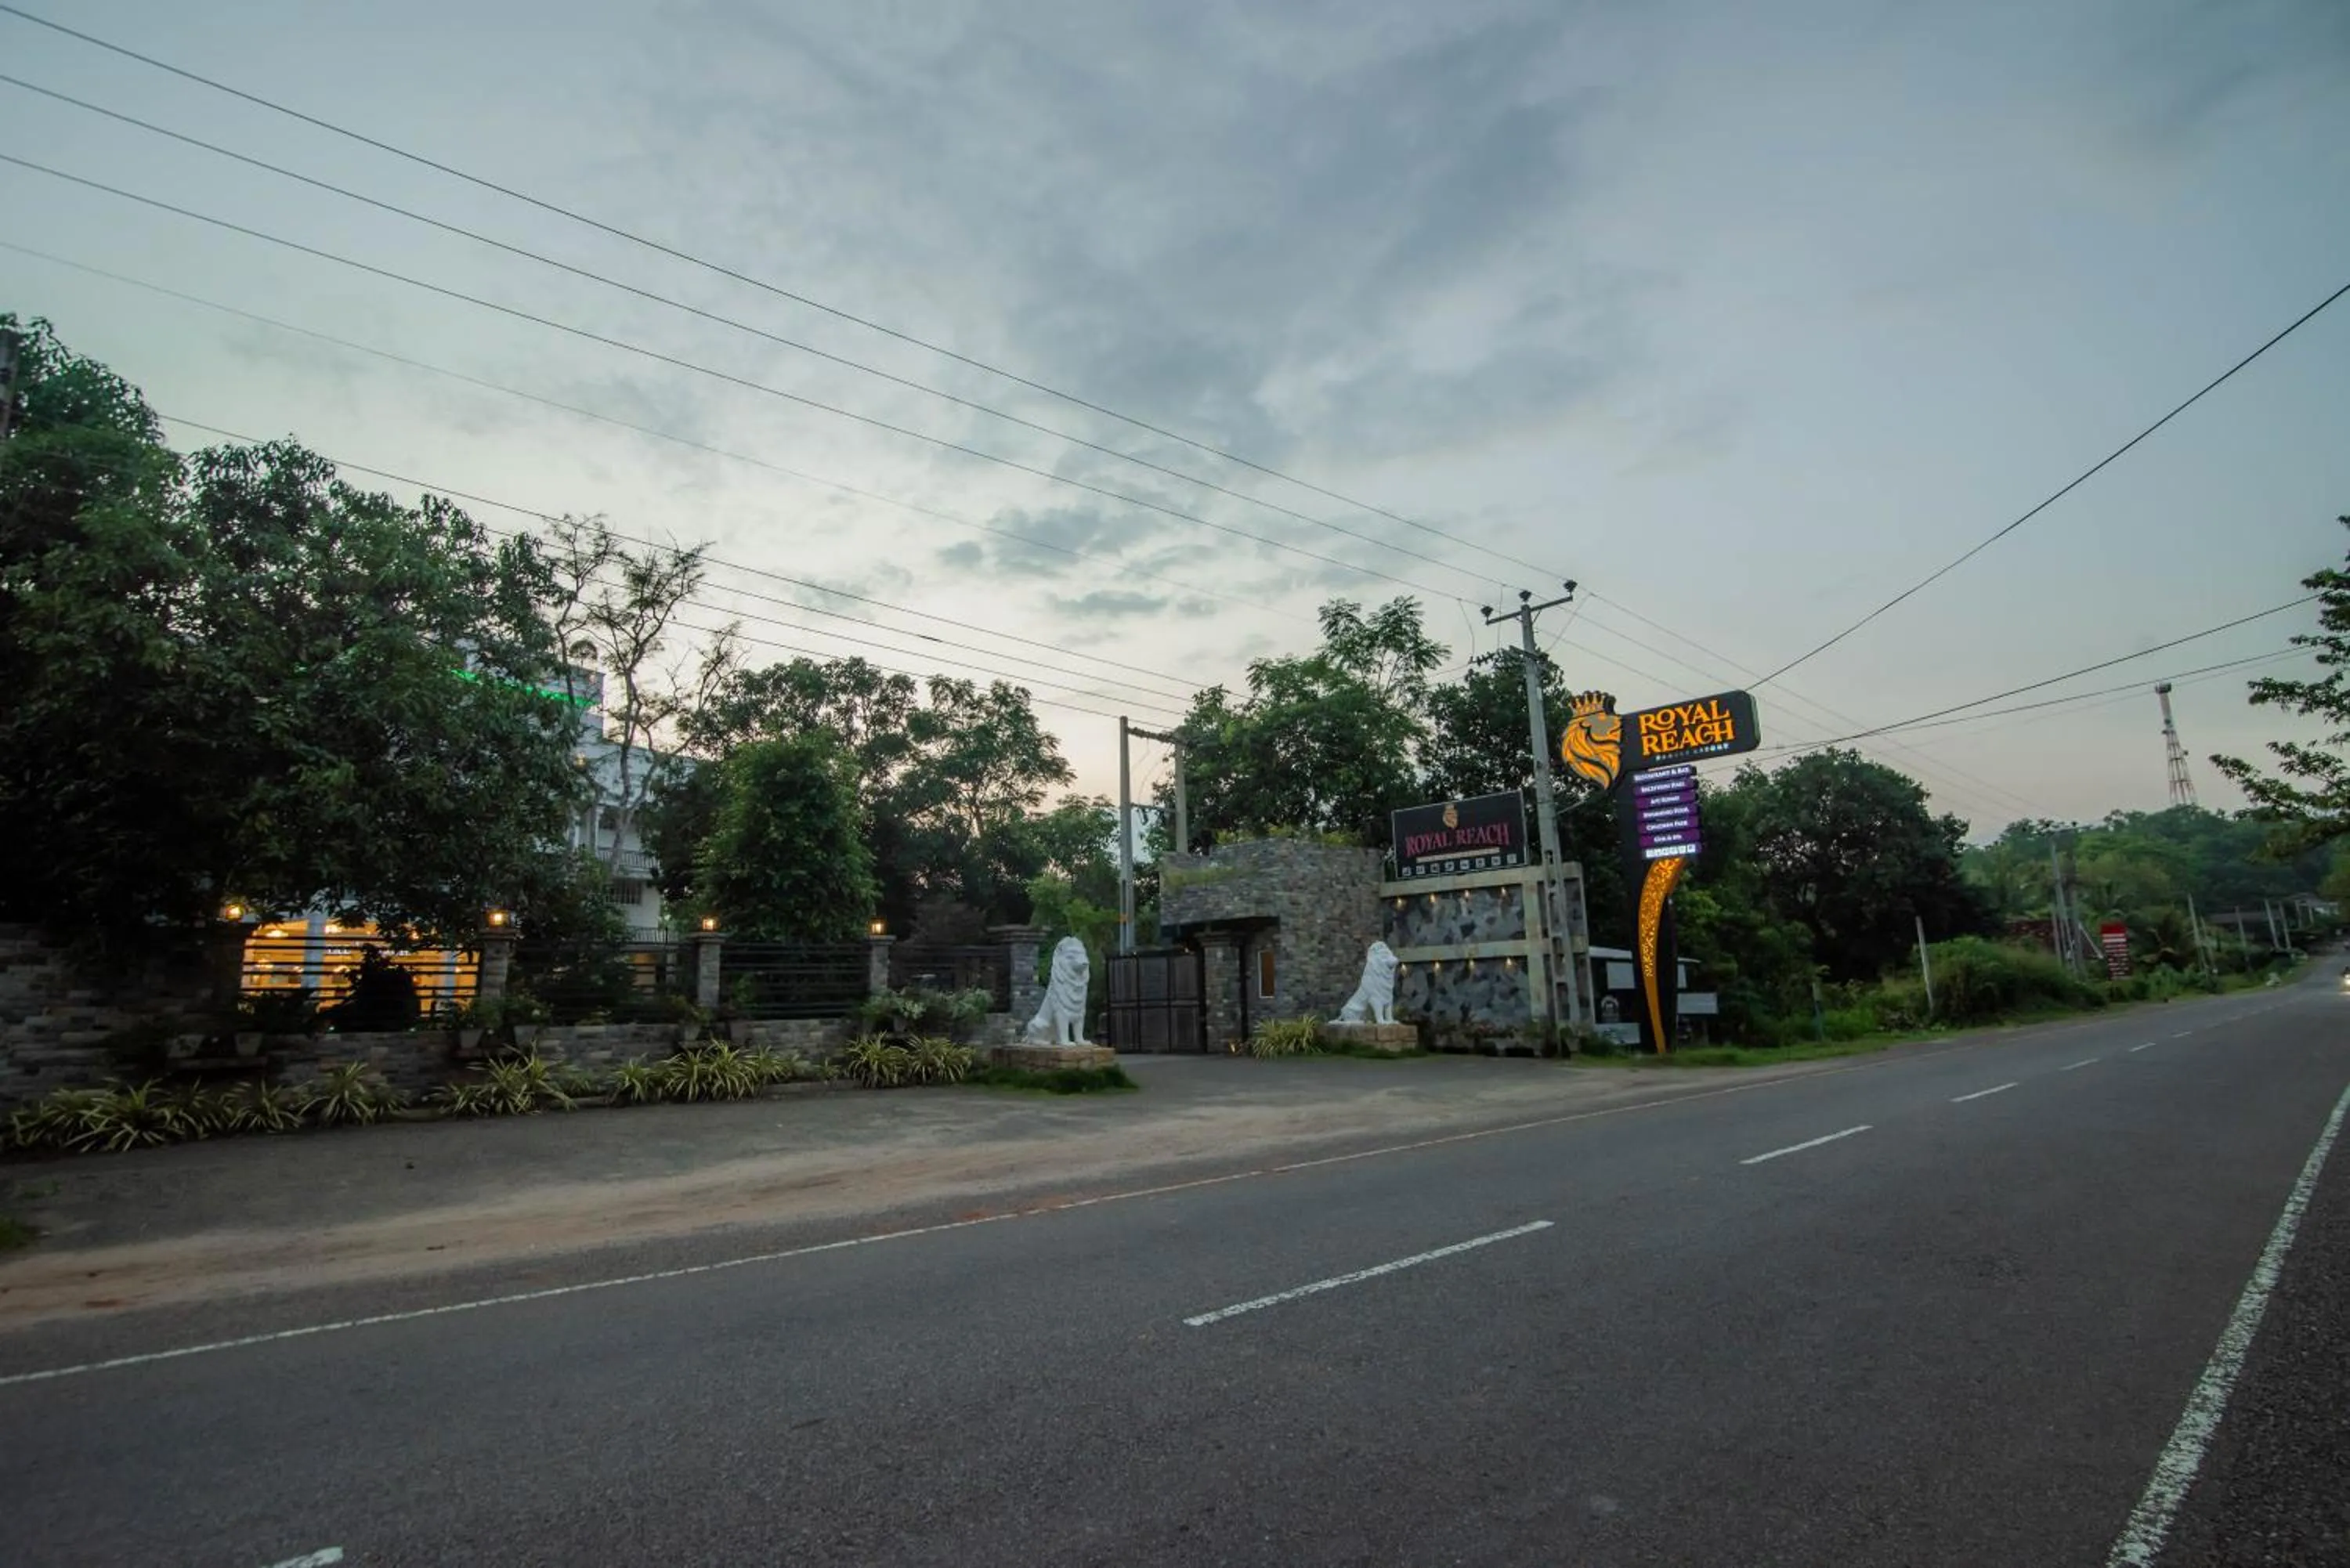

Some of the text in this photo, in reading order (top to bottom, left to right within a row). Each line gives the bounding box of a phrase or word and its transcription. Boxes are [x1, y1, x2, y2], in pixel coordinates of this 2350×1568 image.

[1638, 699, 1730, 735] ROYAL
[1642, 718, 1734, 756] REACH
[1405, 822, 1509, 858] ROYAL REACH
